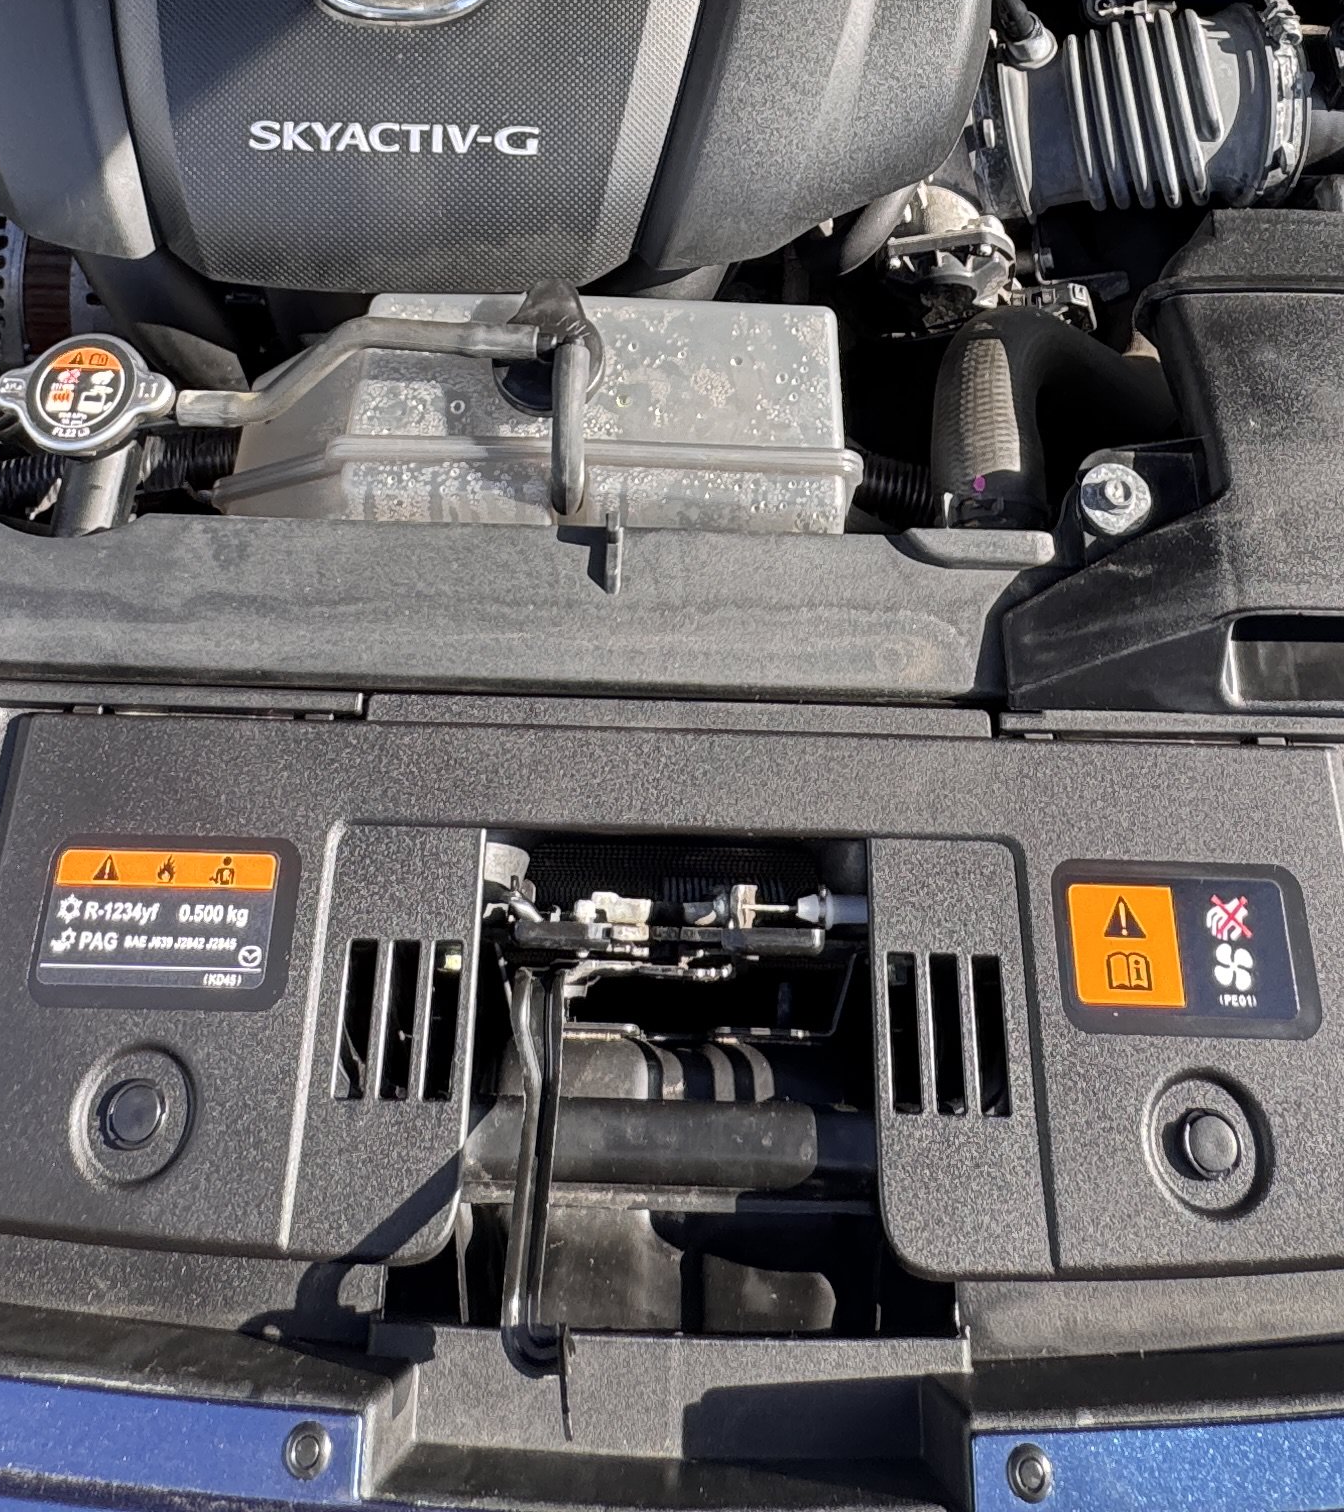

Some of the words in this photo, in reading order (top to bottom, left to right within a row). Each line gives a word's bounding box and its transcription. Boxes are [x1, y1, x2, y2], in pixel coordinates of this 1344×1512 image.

[248, 120, 540, 156] SKYACTIV-G
[83, 901, 160, 925] R-1234yf
[178, 904, 224, 923] 0.500
[226, 905, 250, 927] kg
[78, 931, 118, 951] PAG
[1219, 994, 1257, 1008] (PE01)
